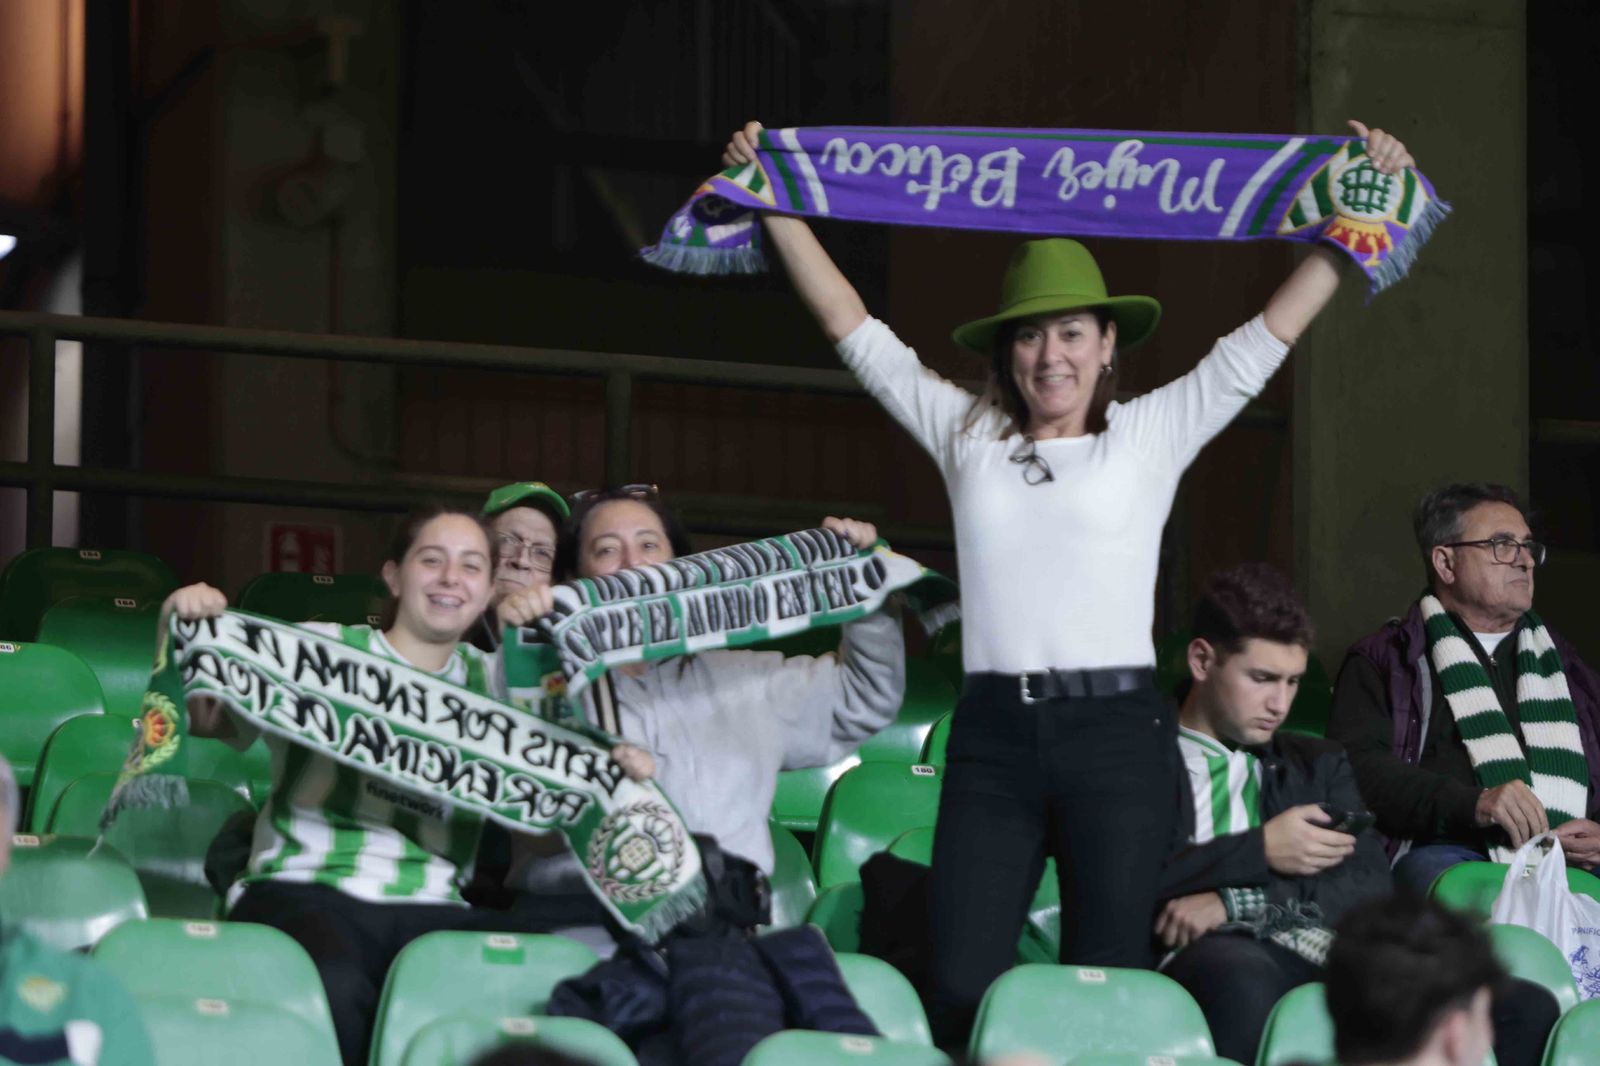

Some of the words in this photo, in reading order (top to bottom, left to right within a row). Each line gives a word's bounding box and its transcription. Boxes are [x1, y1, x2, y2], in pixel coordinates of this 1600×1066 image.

[1041, 139, 1226, 214] Mujer
[646, 598, 681, 643] EL
[685, 581, 770, 638] MUNDO
[774, 556, 887, 620] ENTERO
